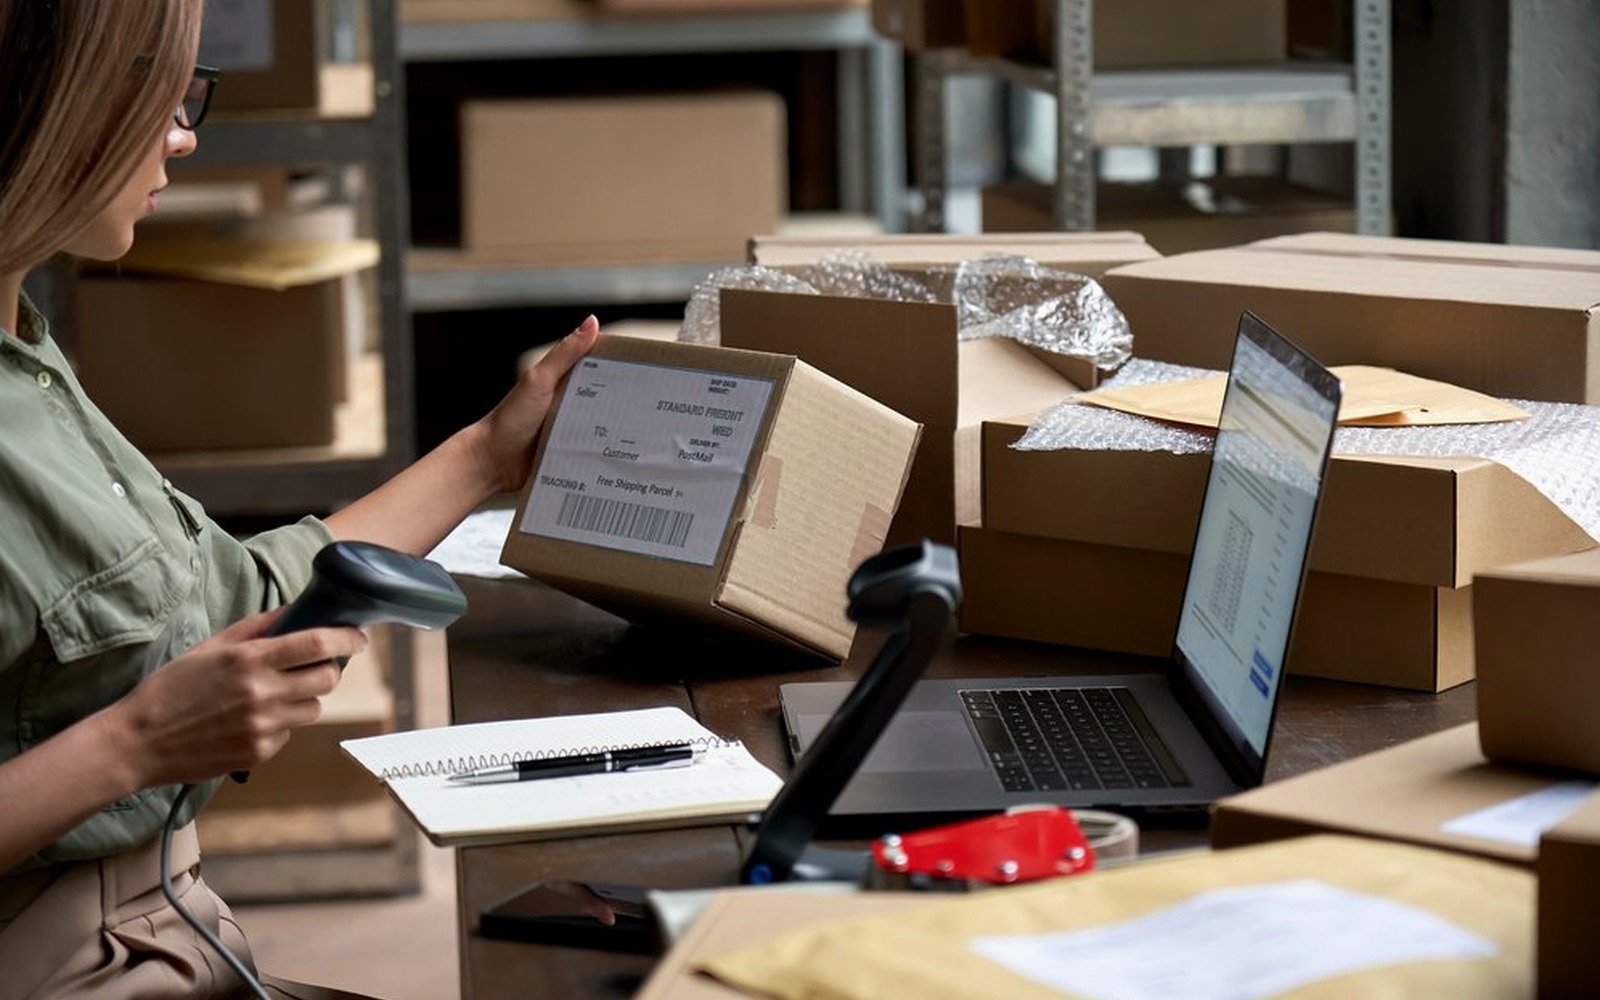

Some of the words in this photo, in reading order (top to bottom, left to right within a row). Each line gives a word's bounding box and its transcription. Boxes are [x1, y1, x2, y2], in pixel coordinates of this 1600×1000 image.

[575, 387, 598, 398] Seller
[656, 400, 704, 416] STANDARD
[704, 407, 744, 422] FREIGHT
[594, 426, 609, 437] TO:
[712, 424, 733, 437] WED
[602, 446, 639, 461] Customer
[677, 449, 714, 463] PostMail
[540, 475, 577, 491] TRACKING
[597, 475, 613, 487] Free
[614, 478, 648, 495] Shipping
[649, 483, 674, 497] Parcel
